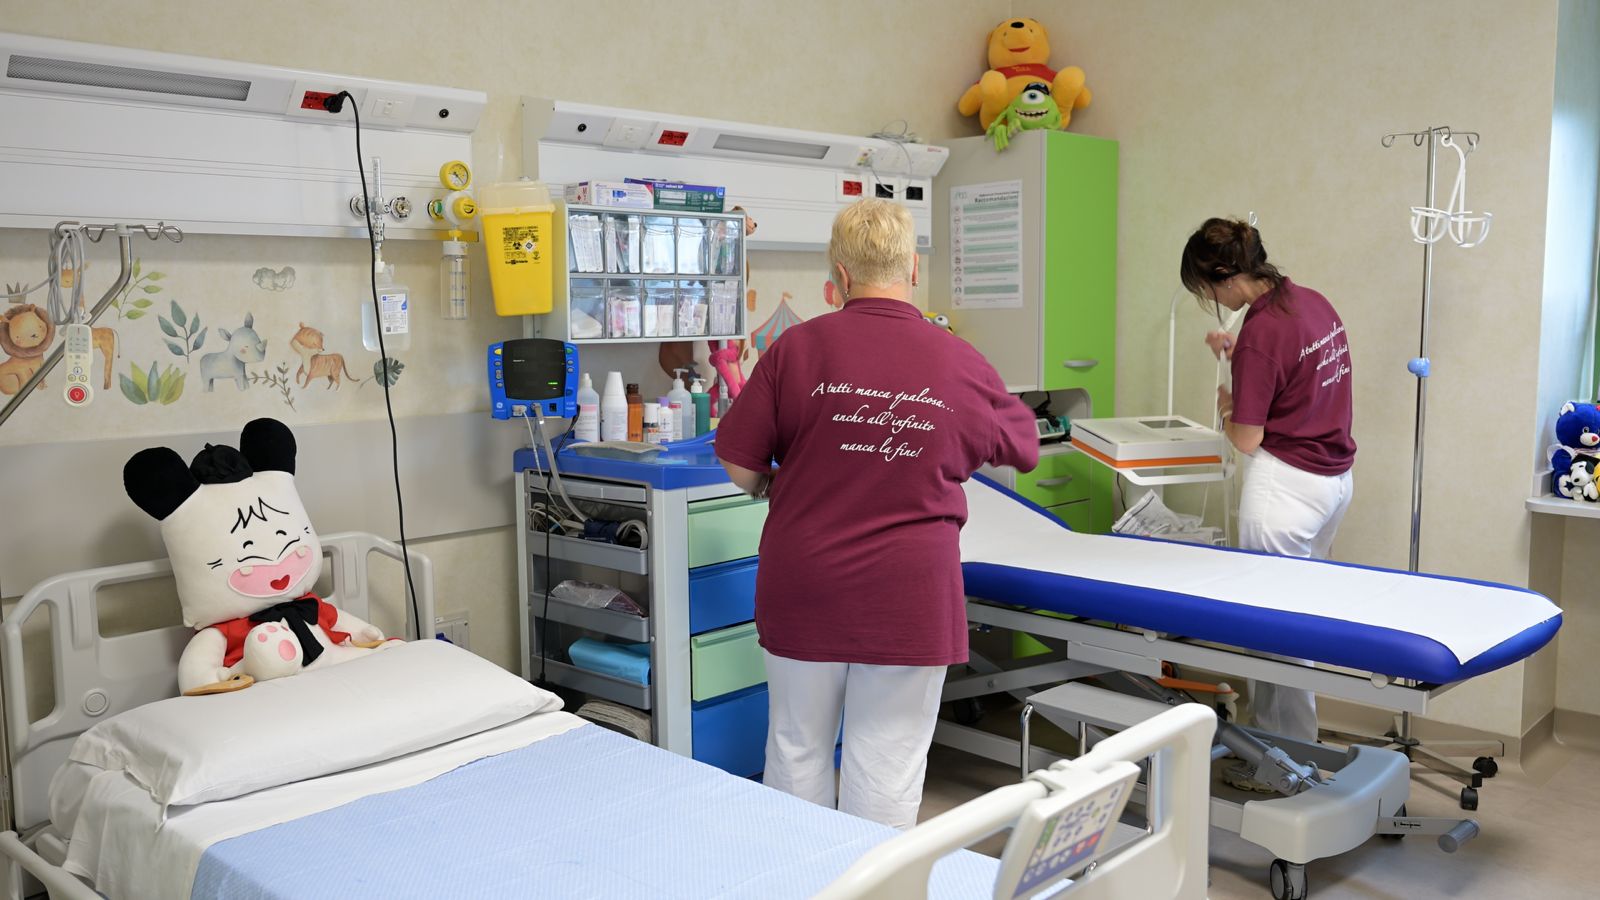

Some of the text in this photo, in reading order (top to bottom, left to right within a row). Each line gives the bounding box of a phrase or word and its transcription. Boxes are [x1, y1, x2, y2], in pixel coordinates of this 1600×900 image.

[812, 382, 825, 397] A
[827, 383, 853, 394] tutti
[855, 387, 893, 399] manca
[832, 404, 936, 434] anche all'infinito
[840, 437, 923, 462] manca la fine!
